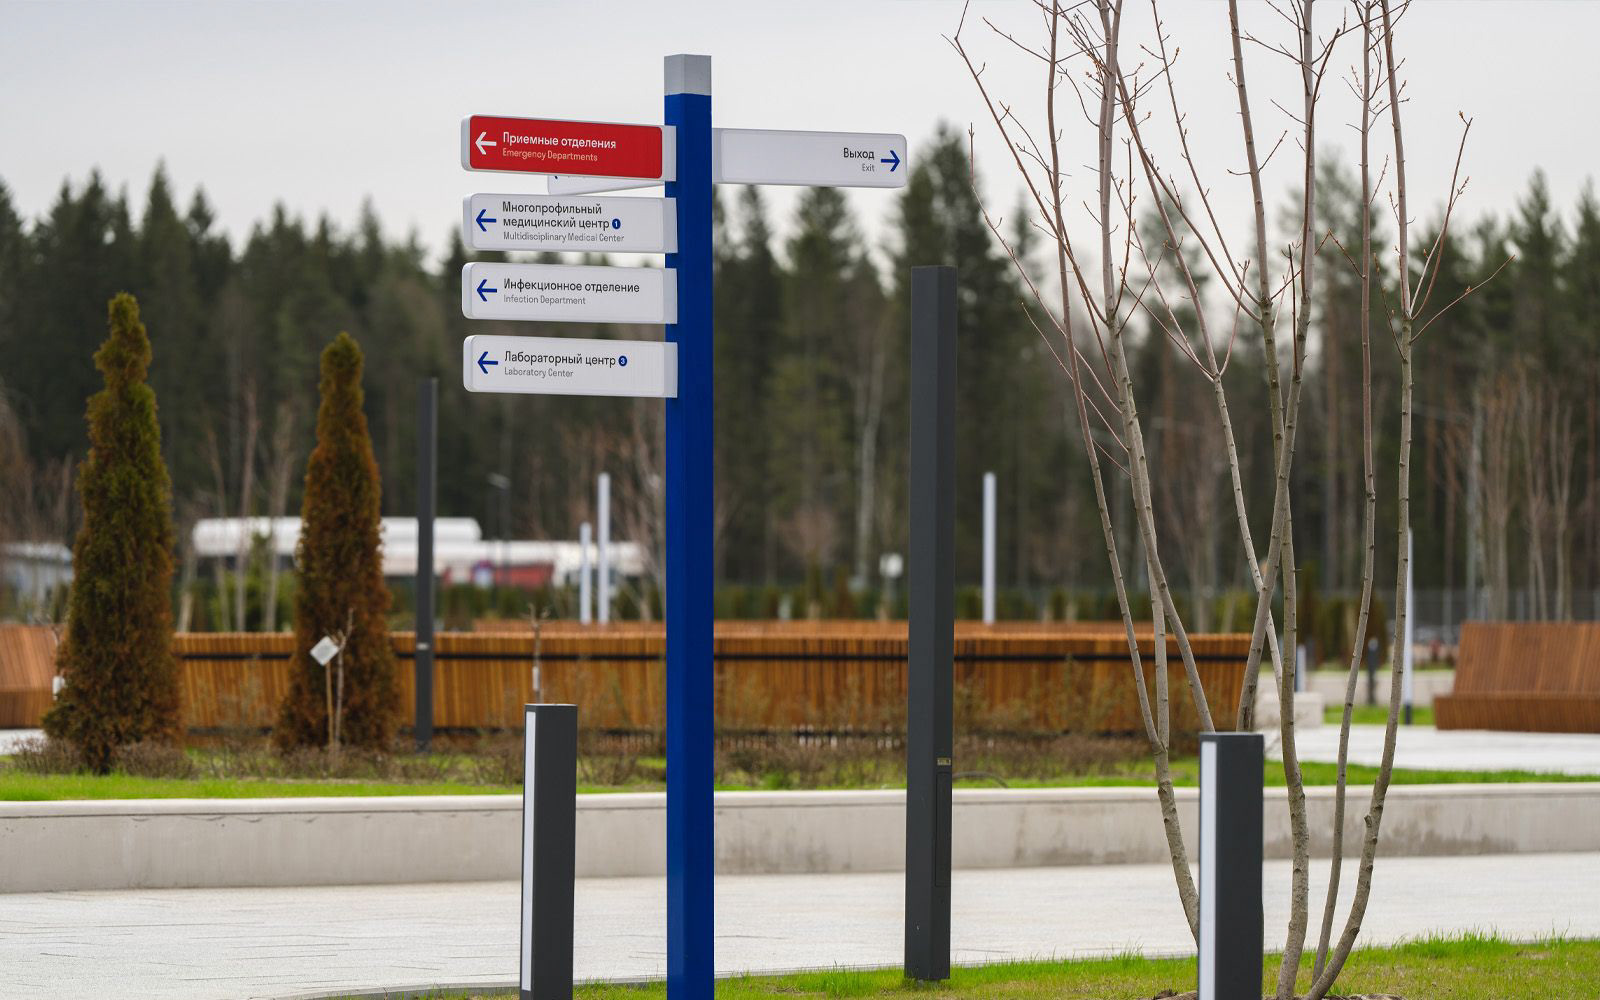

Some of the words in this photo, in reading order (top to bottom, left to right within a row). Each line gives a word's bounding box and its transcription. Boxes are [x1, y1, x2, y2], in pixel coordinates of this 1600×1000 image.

[503, 132, 559, 146] Приемные
[561, 138, 617, 149] отделения
[502, 148, 546, 160] Emergency
[547, 151, 598, 162] Departments
[843, 147, 875, 160] Выход
[861, 163, 875, 172] Exit
[502, 201, 602, 216] Многопрофильный
[503, 217, 576, 229] медицинский
[579, 219, 610, 231] центр
[503, 231, 567, 243] Multidisciplinary
[568, 233, 598, 242] Medical
[599, 234, 625, 242] Center
[503, 278, 582, 292] Инфекционное
[584, 283, 640, 293] отделение
[504, 294, 539, 304] Infection
[540, 295, 586, 306] Department
[504, 351, 583, 366] Лабораторный
[585, 355, 616, 368] центр
[504, 368, 547, 379] Laboratory
[547, 369, 574, 378] Center
